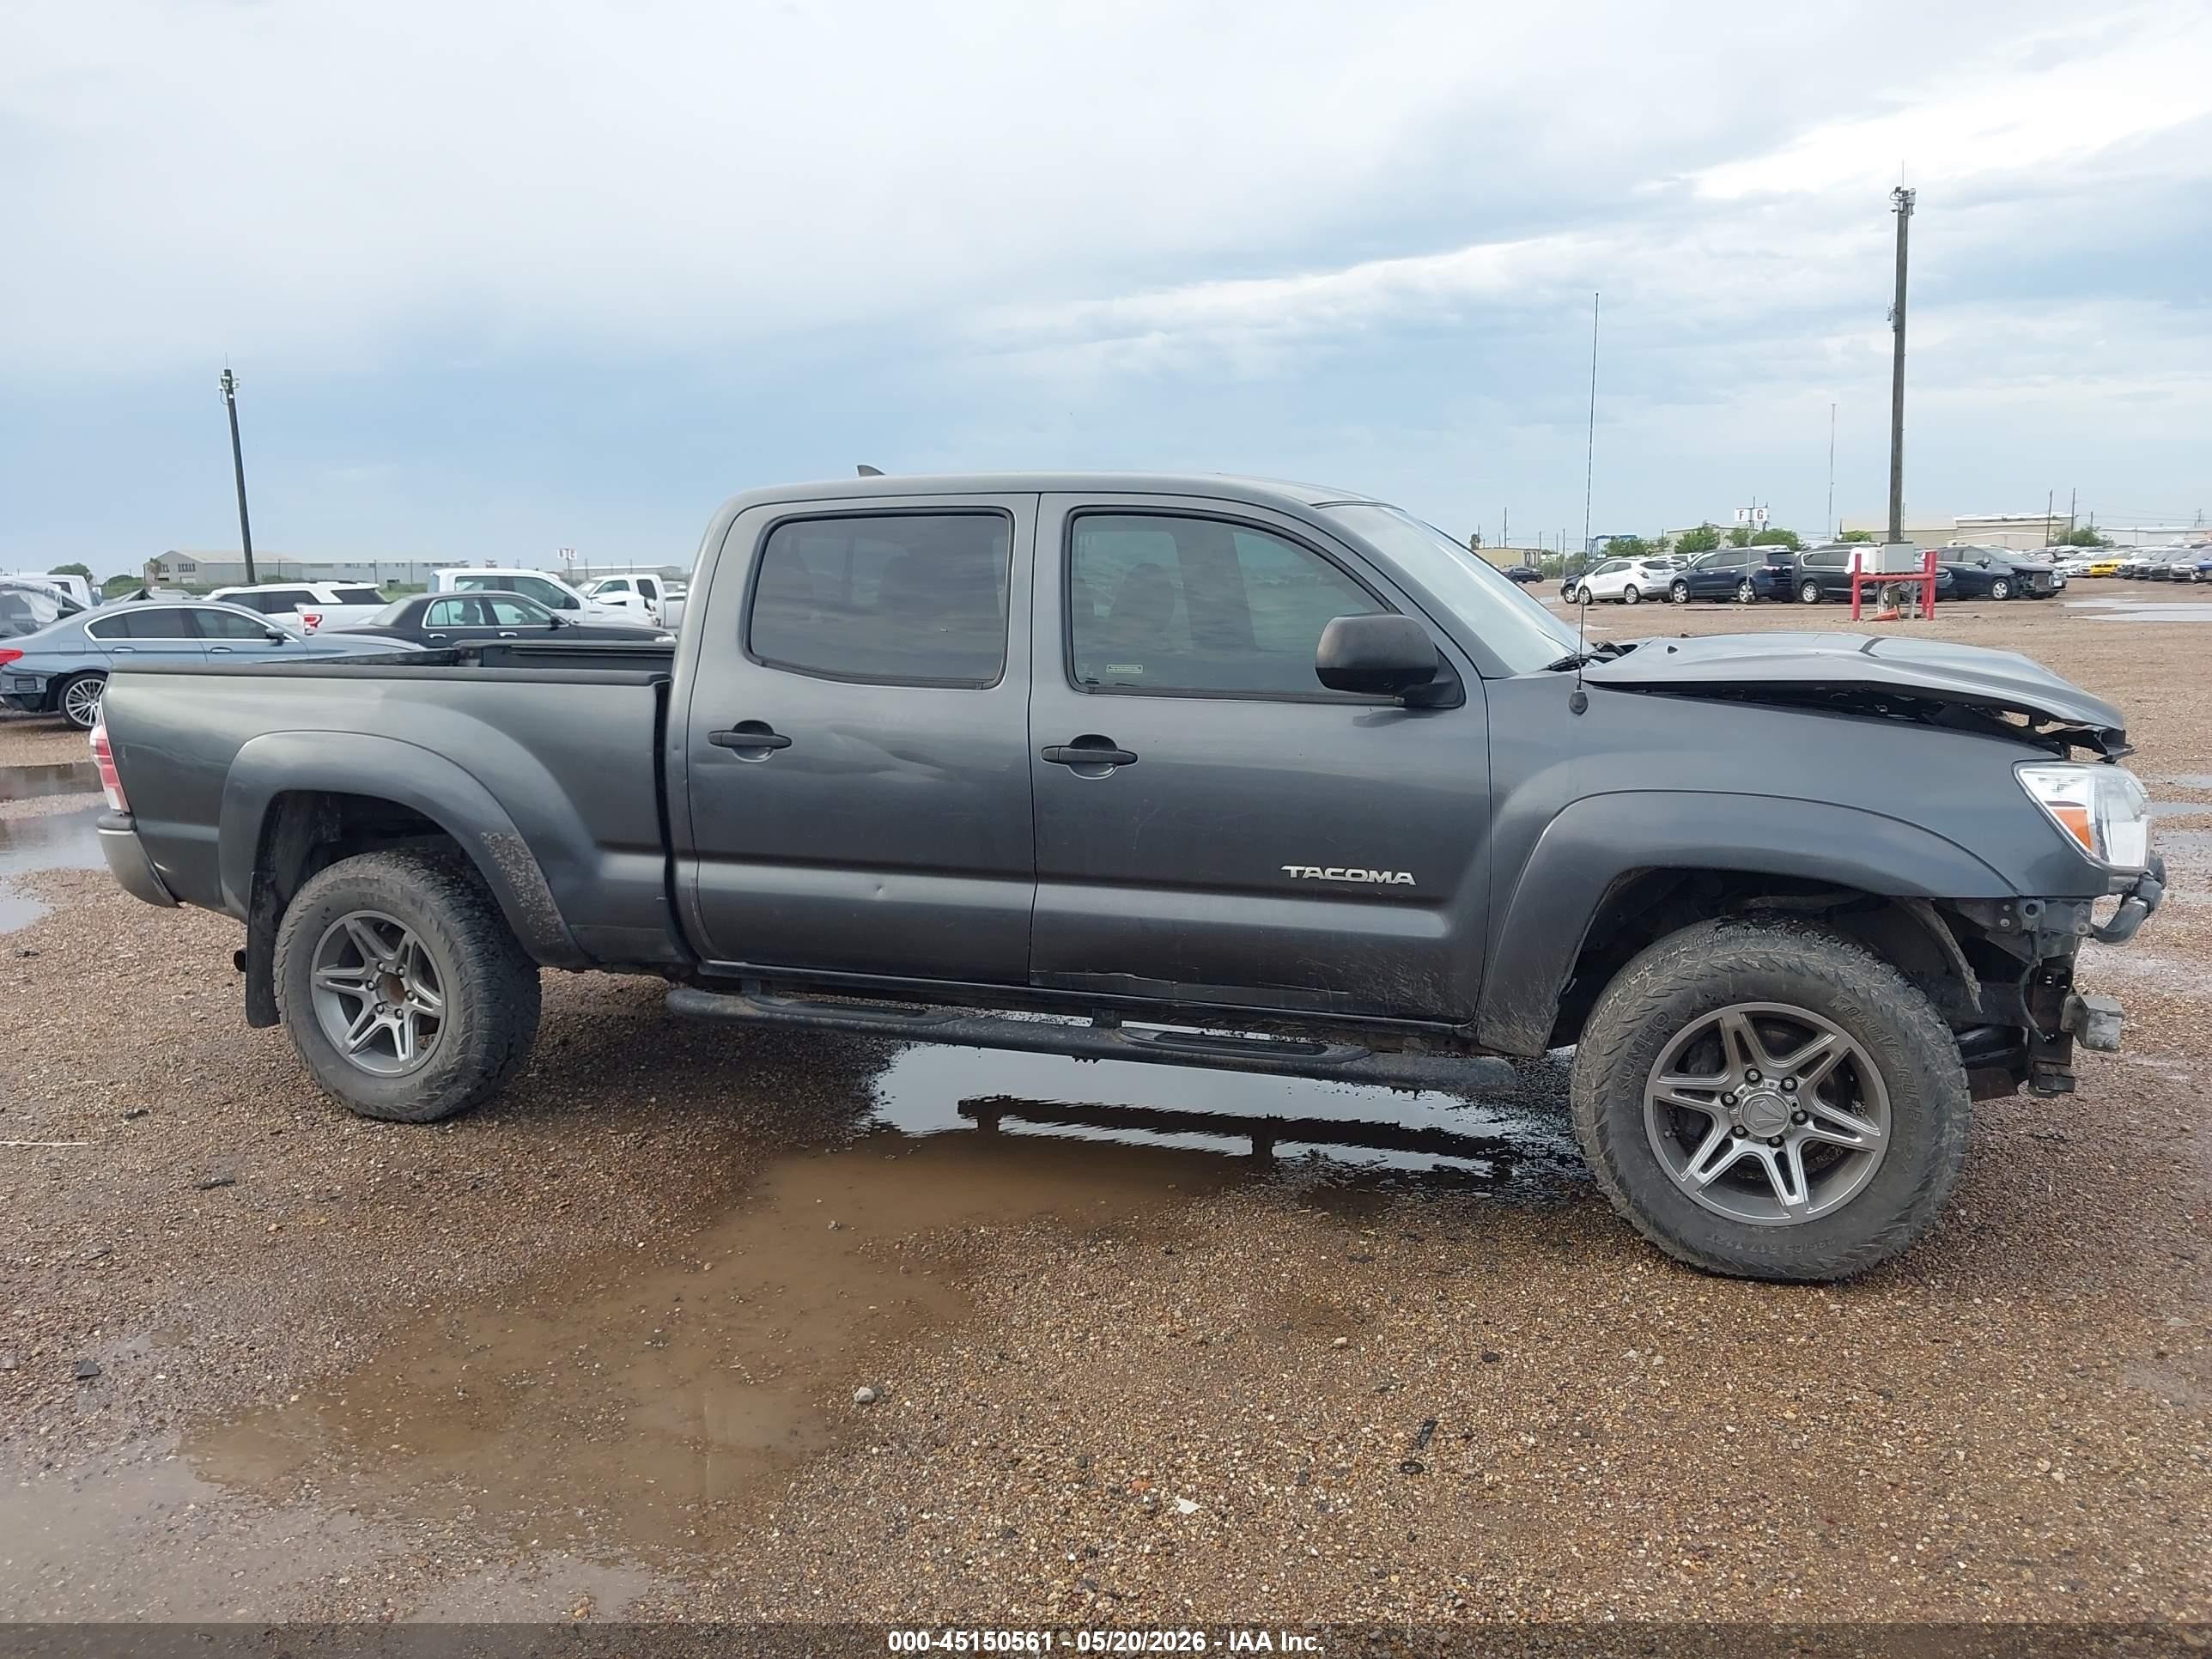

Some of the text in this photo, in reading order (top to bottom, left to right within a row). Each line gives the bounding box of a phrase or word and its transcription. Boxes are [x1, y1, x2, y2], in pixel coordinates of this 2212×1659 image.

[1757, 509, 1764, 520] G
[1279, 865, 1417, 886] TACOMA
[1614, 1010, 1672, 1099] KUMHO
